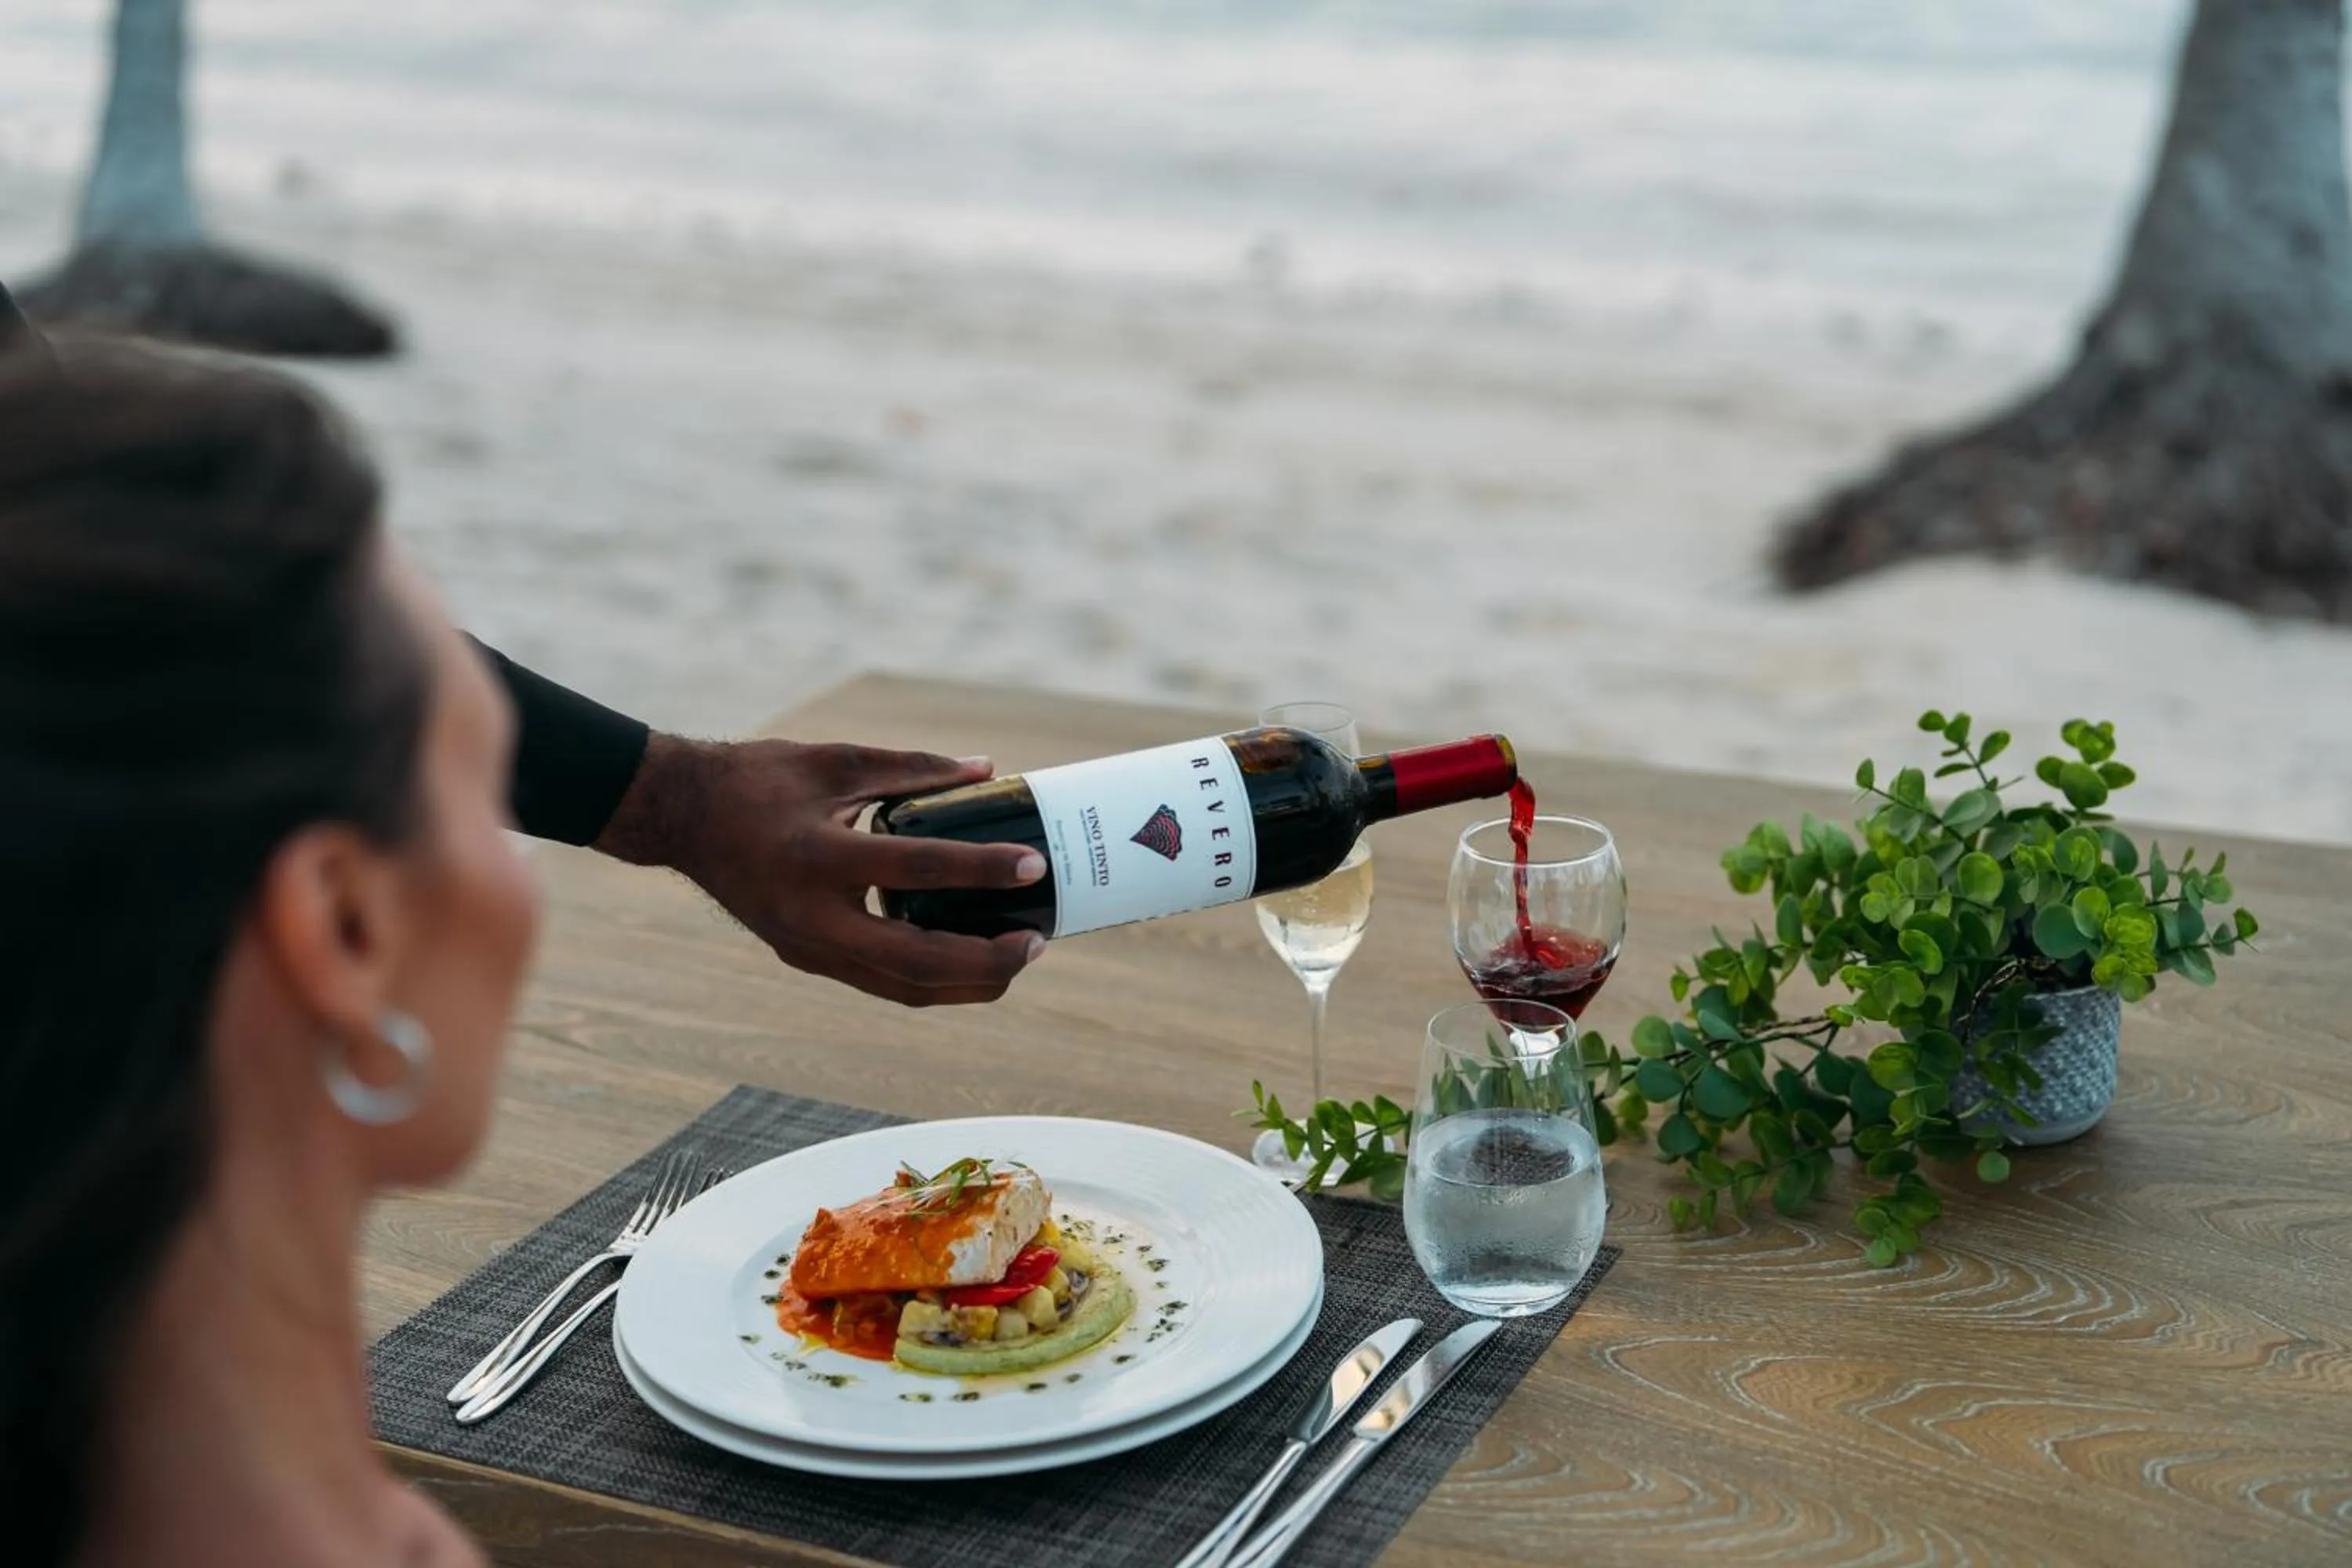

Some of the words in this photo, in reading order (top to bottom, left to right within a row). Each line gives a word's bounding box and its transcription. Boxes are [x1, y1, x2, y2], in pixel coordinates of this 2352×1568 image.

[1087, 806, 1103, 840] VINO
[1191, 757, 1232, 888] REVERO
[1094, 843, 1109, 886] TINTO
